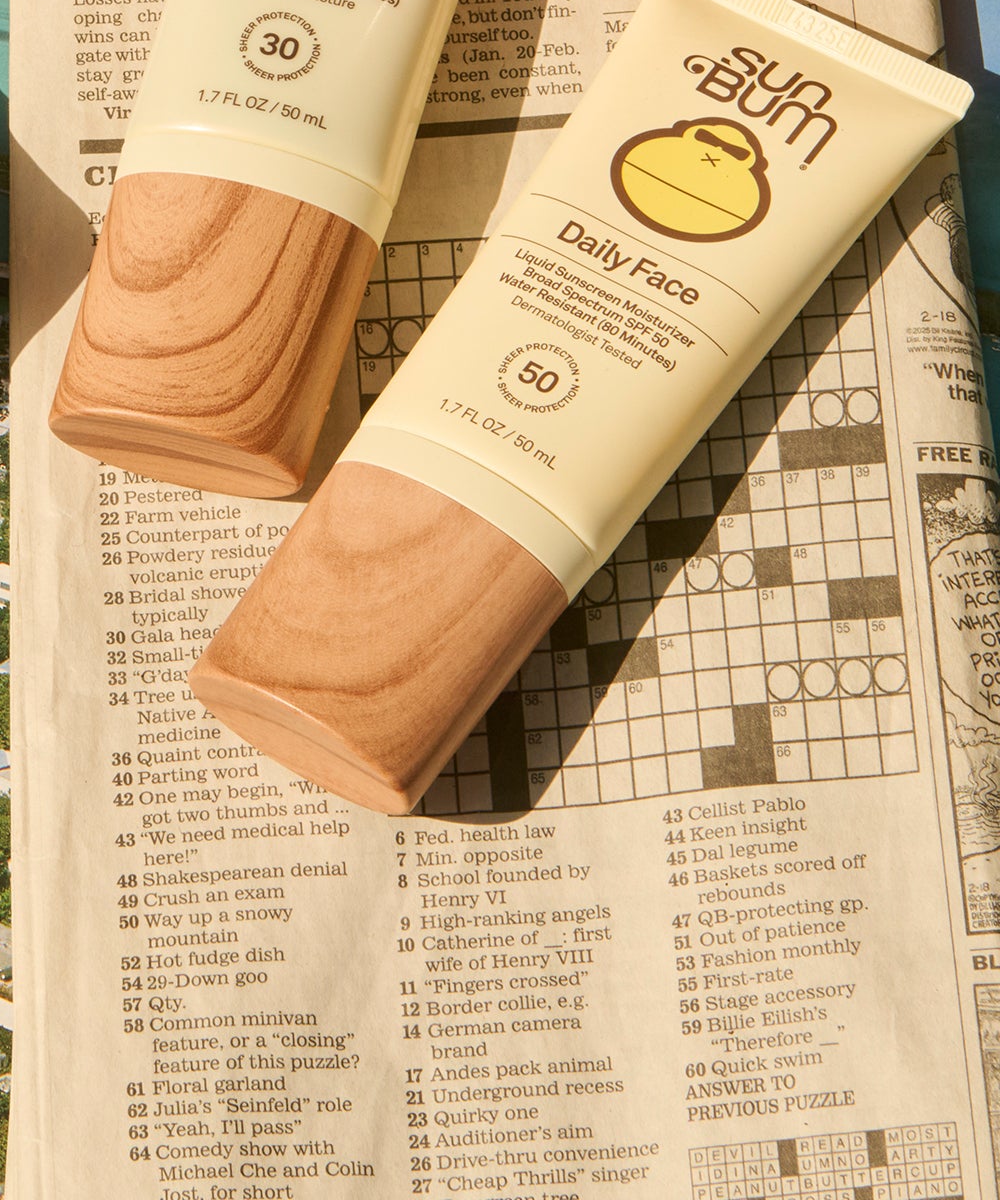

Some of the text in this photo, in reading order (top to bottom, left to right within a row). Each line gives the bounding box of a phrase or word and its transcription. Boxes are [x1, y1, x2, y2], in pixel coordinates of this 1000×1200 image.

[74, 30, 151, 43] wins can
[259, 33, 299, 60] 30
[199, 90, 220, 102] 1.7
[223, 92, 241, 106] FL
[246, 96, 269, 111] OZ
[281, 104, 301, 120] 50
[303, 114, 327, 129] mL
[557, 220, 699, 305] Daily Face
[515, 248, 695, 347] Liquid Sunscreen Moisturizer
[523, 266, 669, 348] Broad Spectrum SPF 50
[499, 272, 676, 372] Water Resistant (80 Minutes)
[921, 311, 957, 322] 2-18
[511, 295, 642, 369] Dermatologist Tested
[518, 361, 559, 393] 50
[440, 399, 463, 413] 1.7
[461, 408, 478, 424] FL
[482, 418, 506, 436] OZ
[514, 434, 534, 452] 50
[533, 450, 556, 470] mL
[100, 506, 240, 526] 22 Farm vehicle
[112, 763, 259, 786] 40 Parting word
[663, 797, 805, 824] 43 Cellist Pablo
[117, 861, 347, 888] 48 Shakespearean denial
[401, 905, 611, 932] 9 High-ranking angels
[406, 1056, 612, 1083] 17 Andes pack animal
[127, 1076, 286, 1097] 61 Floral garland
[686, 1074, 795, 1100] ANSWER TO
[688, 1090, 855, 1121] PREVIOUS PUZZLE
